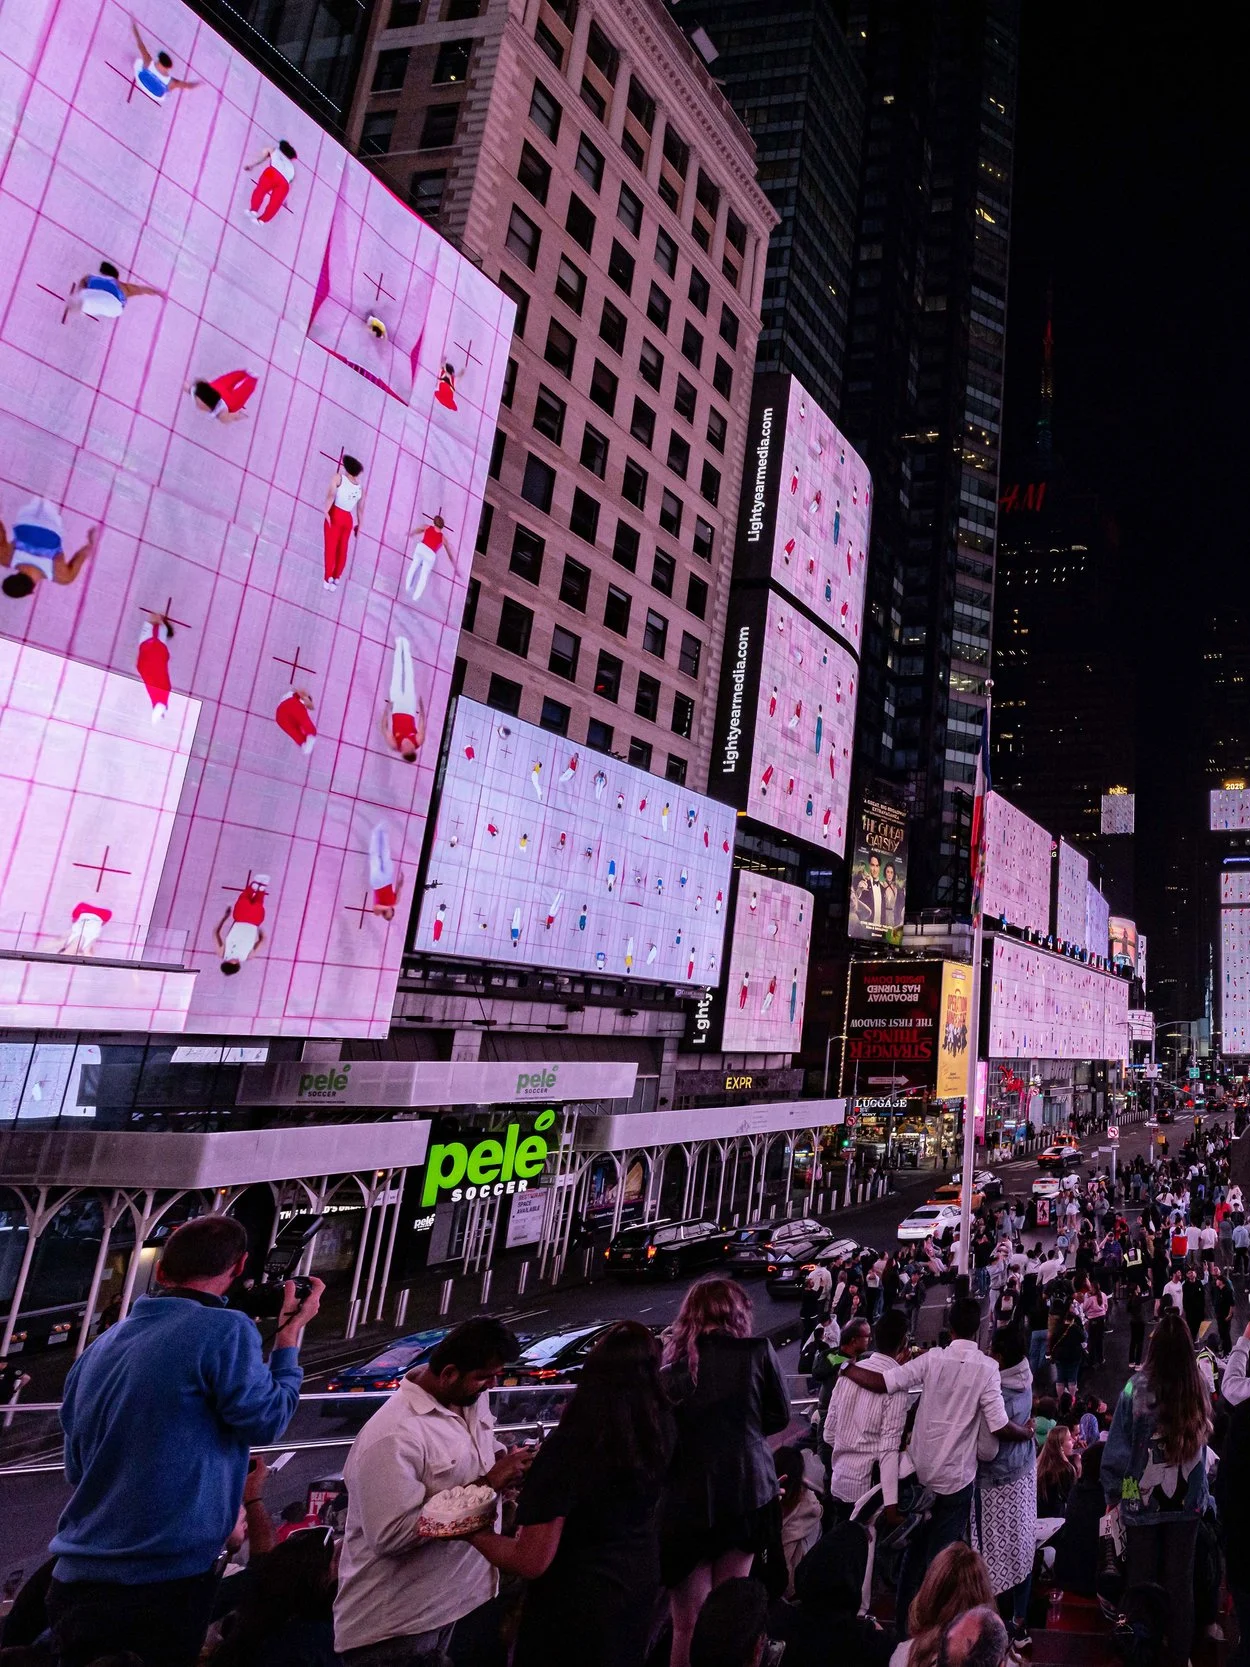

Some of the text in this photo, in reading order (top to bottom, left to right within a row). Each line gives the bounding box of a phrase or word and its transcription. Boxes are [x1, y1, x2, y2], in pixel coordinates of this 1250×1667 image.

[748, 407, 773, 543] Lightyearmedia.com
[998, 482, 1046, 513] HM
[722, 626, 750, 773] Lightyearmedia.com
[878, 822, 904, 842] GREAT
[866, 832, 900, 853] GATSBY
[864, 975, 925, 985] UPSIDE DOWN
[867, 984, 921, 994] HAS TURNED
[868, 993, 919, 1003] BROADWAY
[692, 986, 712, 1044] Lghty
[850, 1018, 933, 1028] THE FIRST SHADOW
[863, 1029, 919, 1043] THINGS
[850, 1040, 932, 1059] STRANGER
[298, 1063, 352, 1097] pelé
[516, 1064, 559, 1094] pelé
[421, 1109, 555, 1208] pelé
[451, 1179, 528, 1203] SOCCER
[517, 1200, 532, 1208] SPACE
[517, 1205, 540, 1214] AVAILABLE
